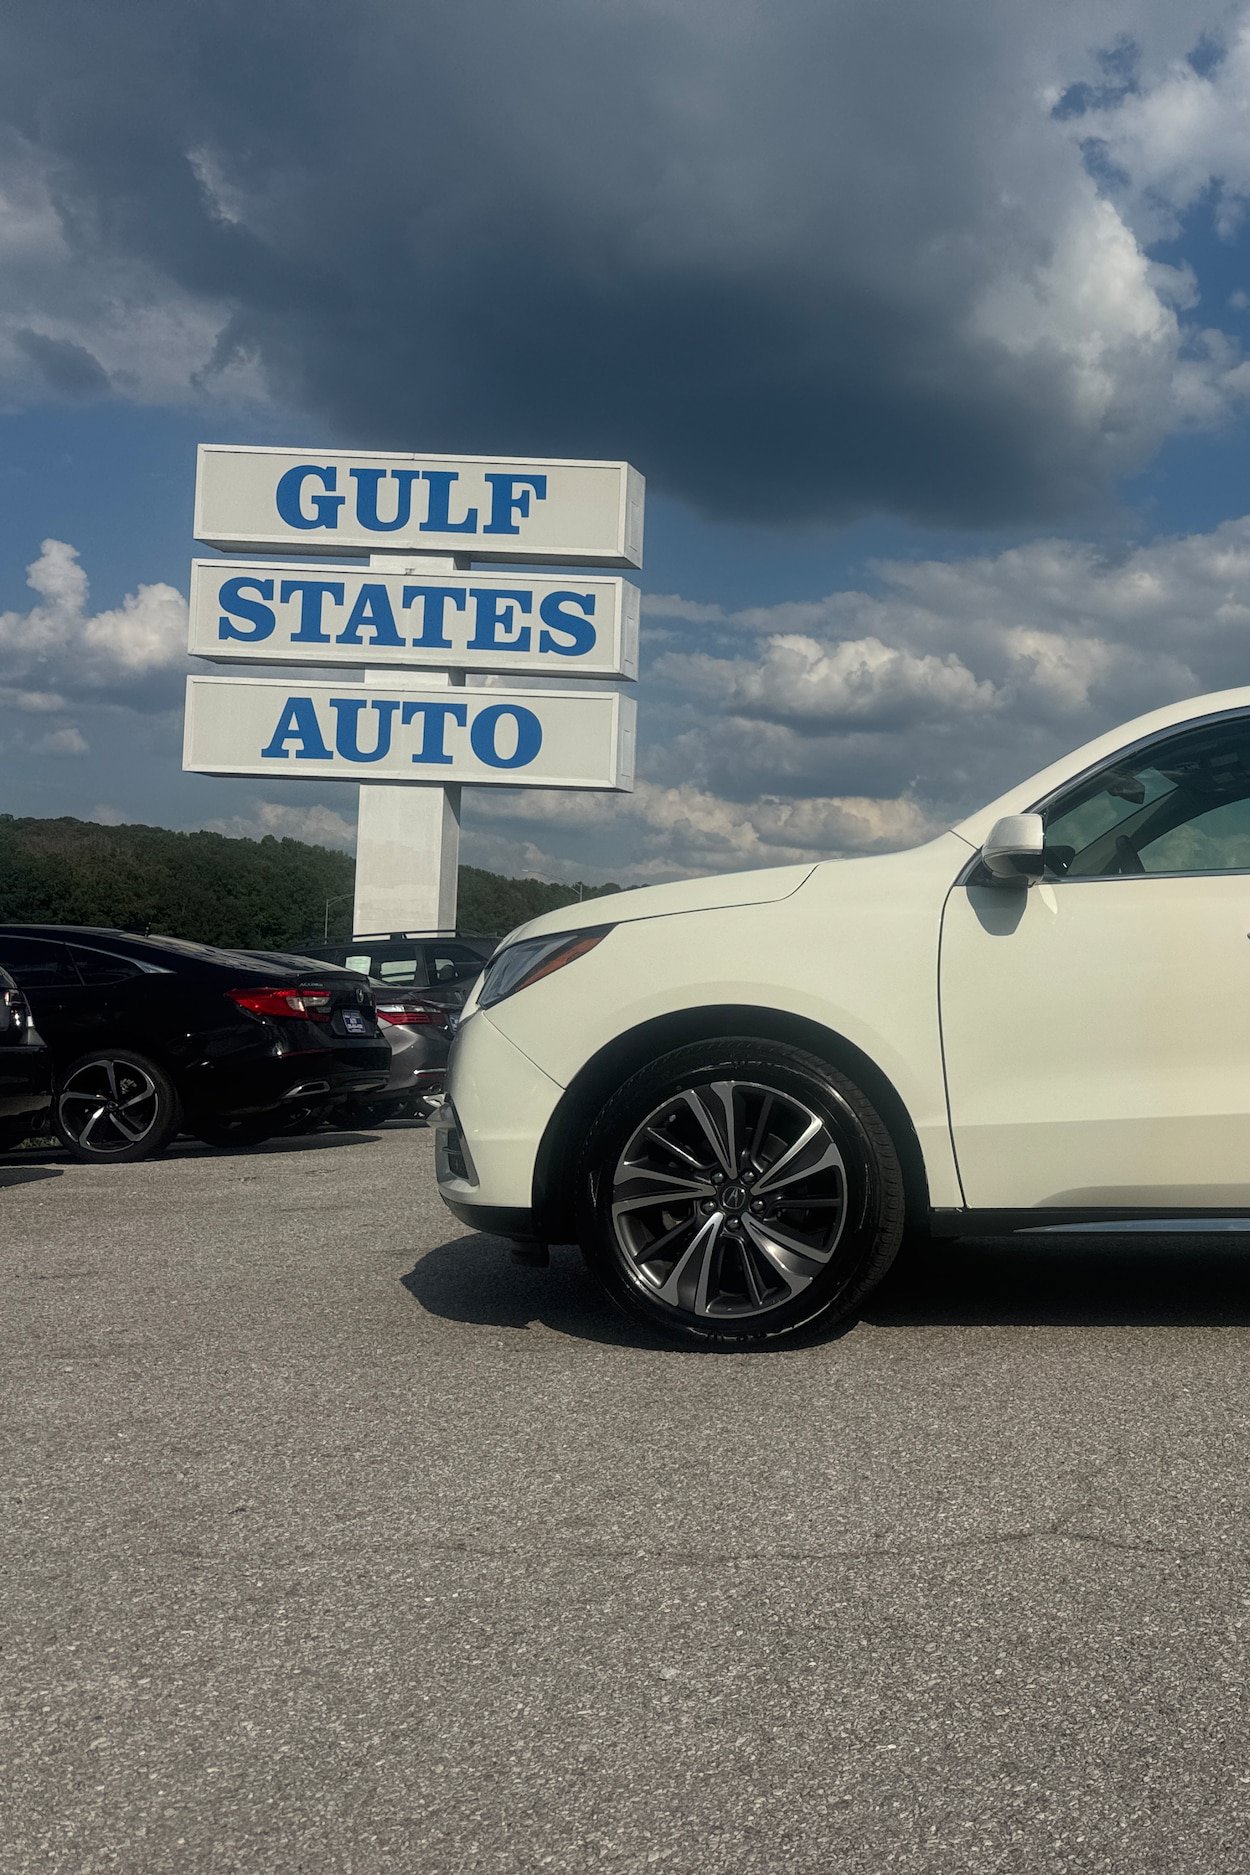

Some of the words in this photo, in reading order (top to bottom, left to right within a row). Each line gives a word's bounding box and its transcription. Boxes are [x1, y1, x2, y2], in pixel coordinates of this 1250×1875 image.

[276, 465, 547, 535] GULF
[218, 577, 596, 656] STATES
[261, 697, 542, 769] AUTO
